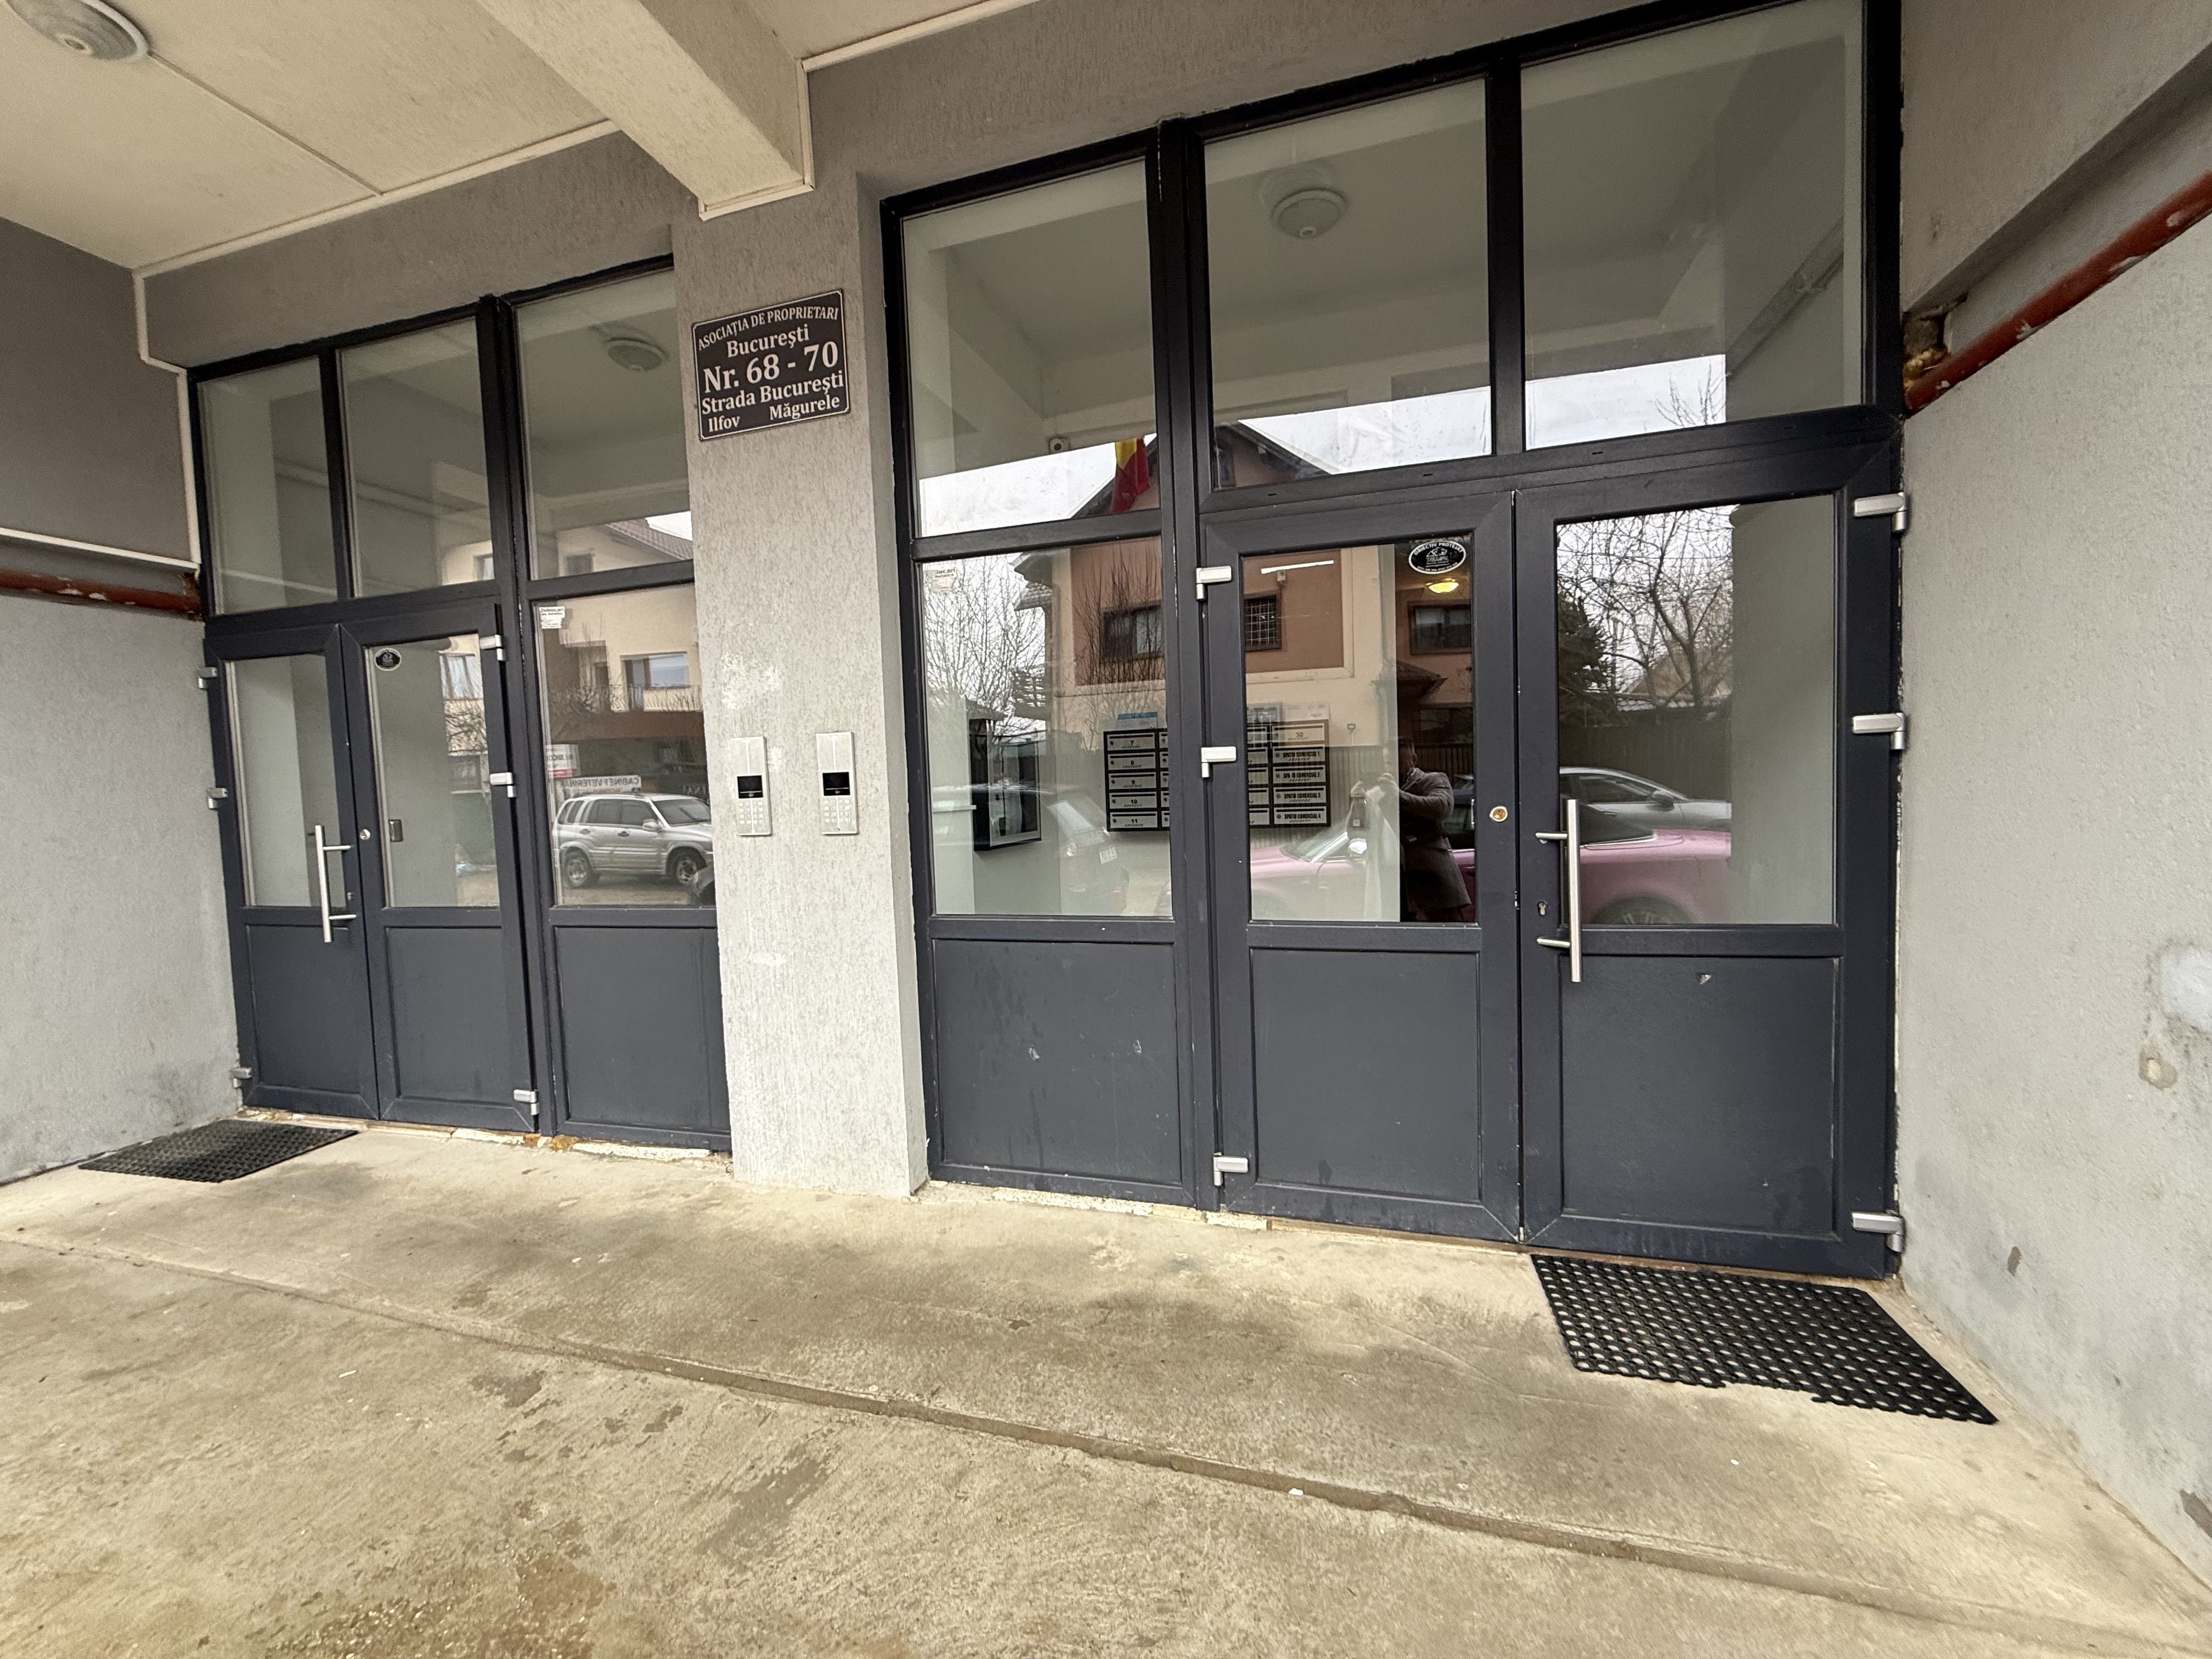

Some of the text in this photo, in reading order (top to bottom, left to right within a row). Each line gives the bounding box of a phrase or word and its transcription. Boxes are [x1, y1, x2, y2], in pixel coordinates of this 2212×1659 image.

[751, 312, 765, 328] DE
[767, 306, 839, 323] PROPRIETARI
[703, 366, 740, 393] Nr.
[746, 354, 780, 384] 68
[804, 341, 838, 372] 70
[702, 391, 757, 415] Strada
[708, 394, 840, 432] Ilfov Măgurele
[1414, 543, 1437, 555] OBIECTIV
